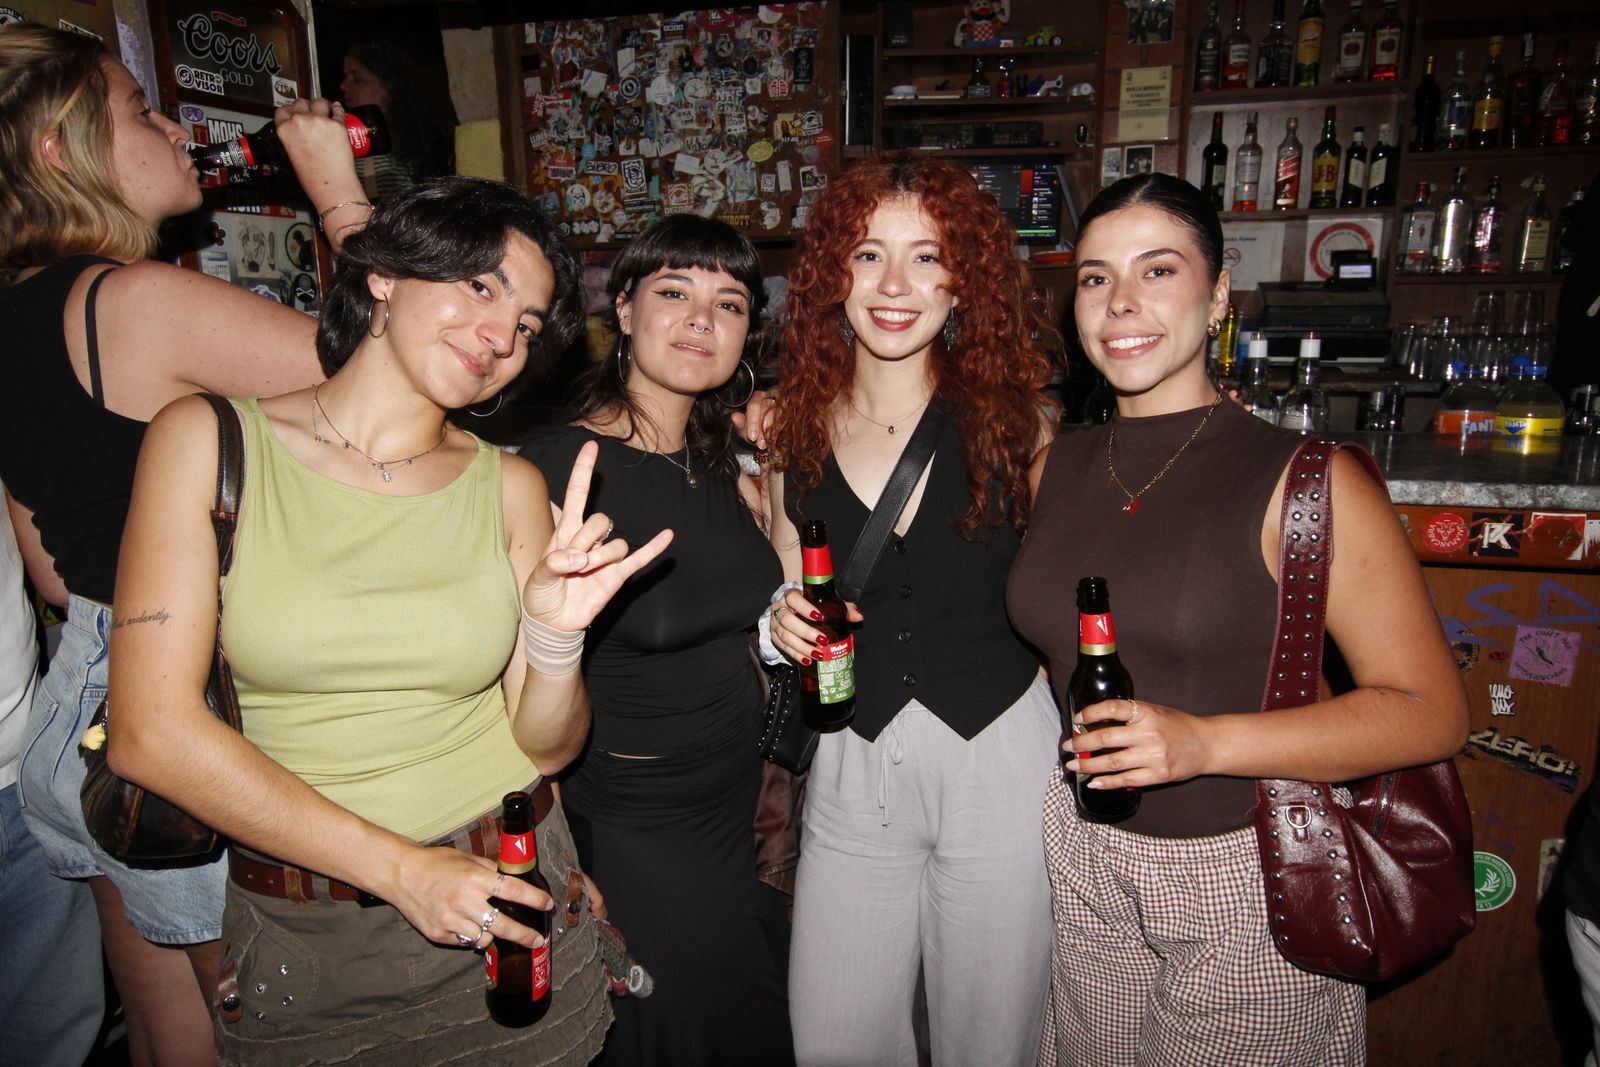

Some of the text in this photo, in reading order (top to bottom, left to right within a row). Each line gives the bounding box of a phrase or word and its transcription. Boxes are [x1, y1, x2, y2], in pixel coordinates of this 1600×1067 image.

[177, 13, 282, 76] Coors
[194, 69, 223, 85] RETRO
[219, 67, 254, 87] GOLD
[194, 79, 223, 94] VISOR
[1313, 164, 1336, 184] J&B
[1461, 418, 1495, 435] FANT
